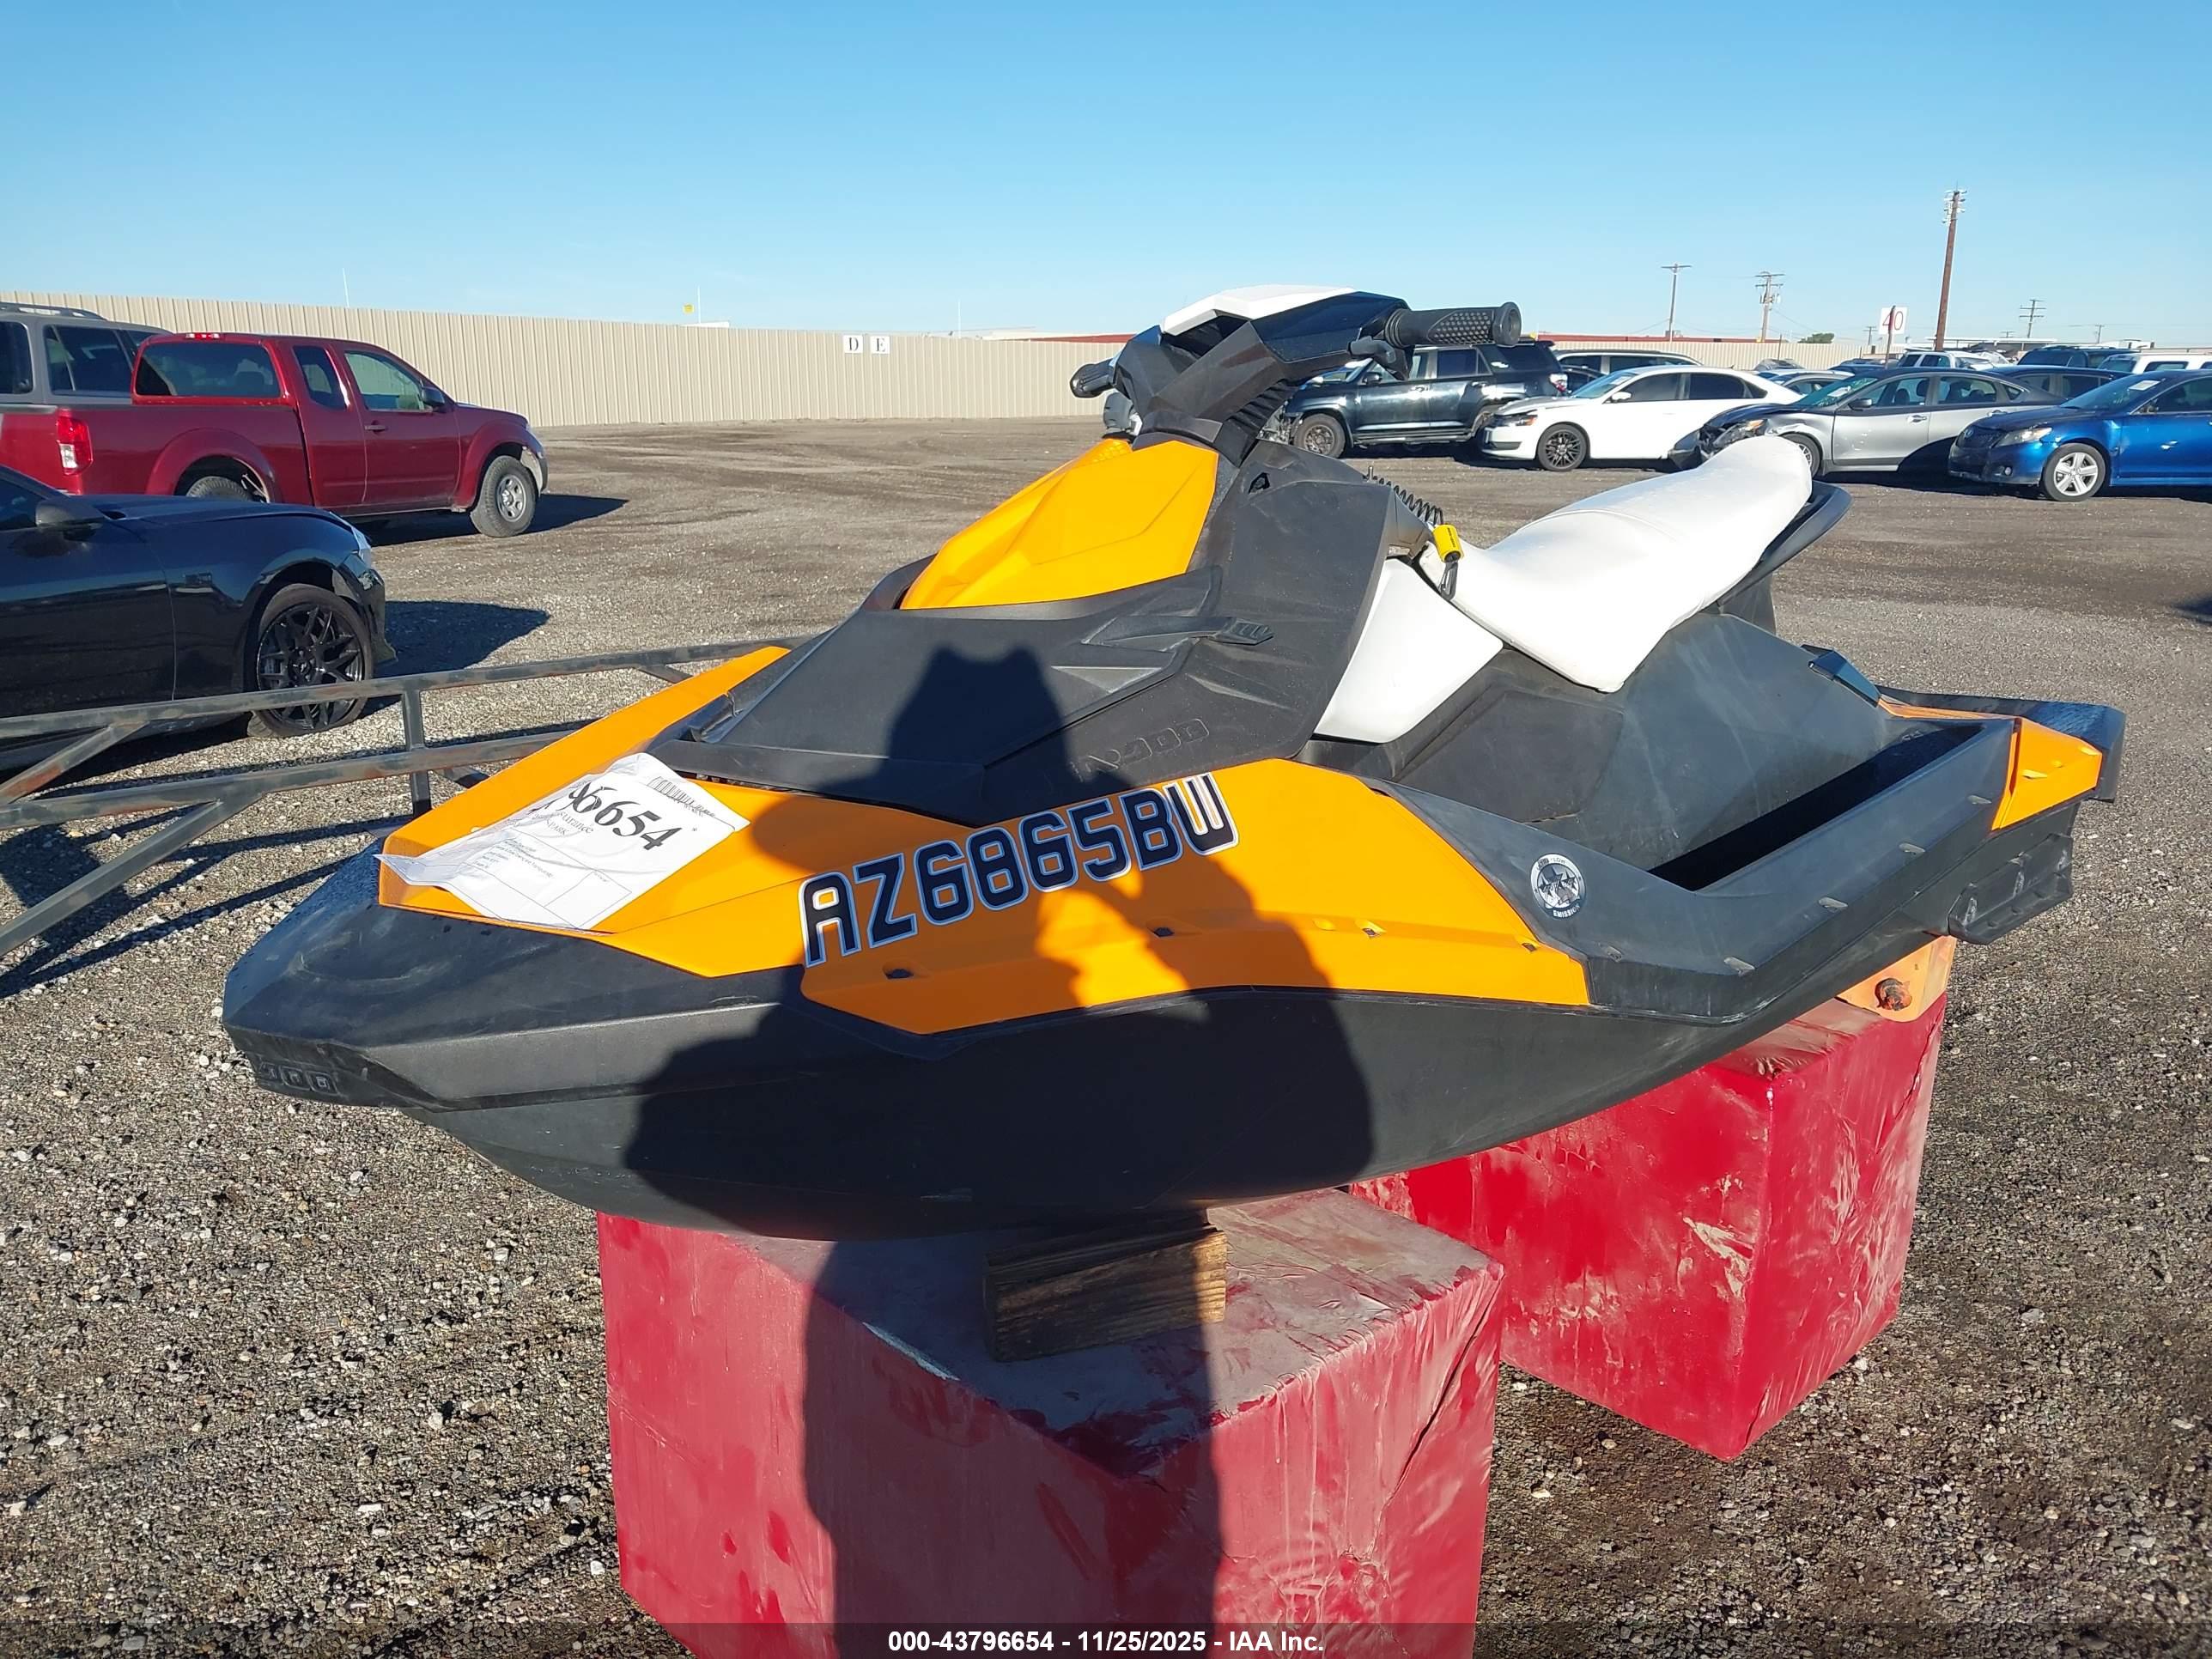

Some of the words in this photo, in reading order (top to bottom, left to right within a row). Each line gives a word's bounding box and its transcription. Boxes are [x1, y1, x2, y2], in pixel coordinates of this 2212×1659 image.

[848, 337, 859, 351] D
[876, 337, 886, 352] E
[798, 772, 1239, 968] AZ6865BW
